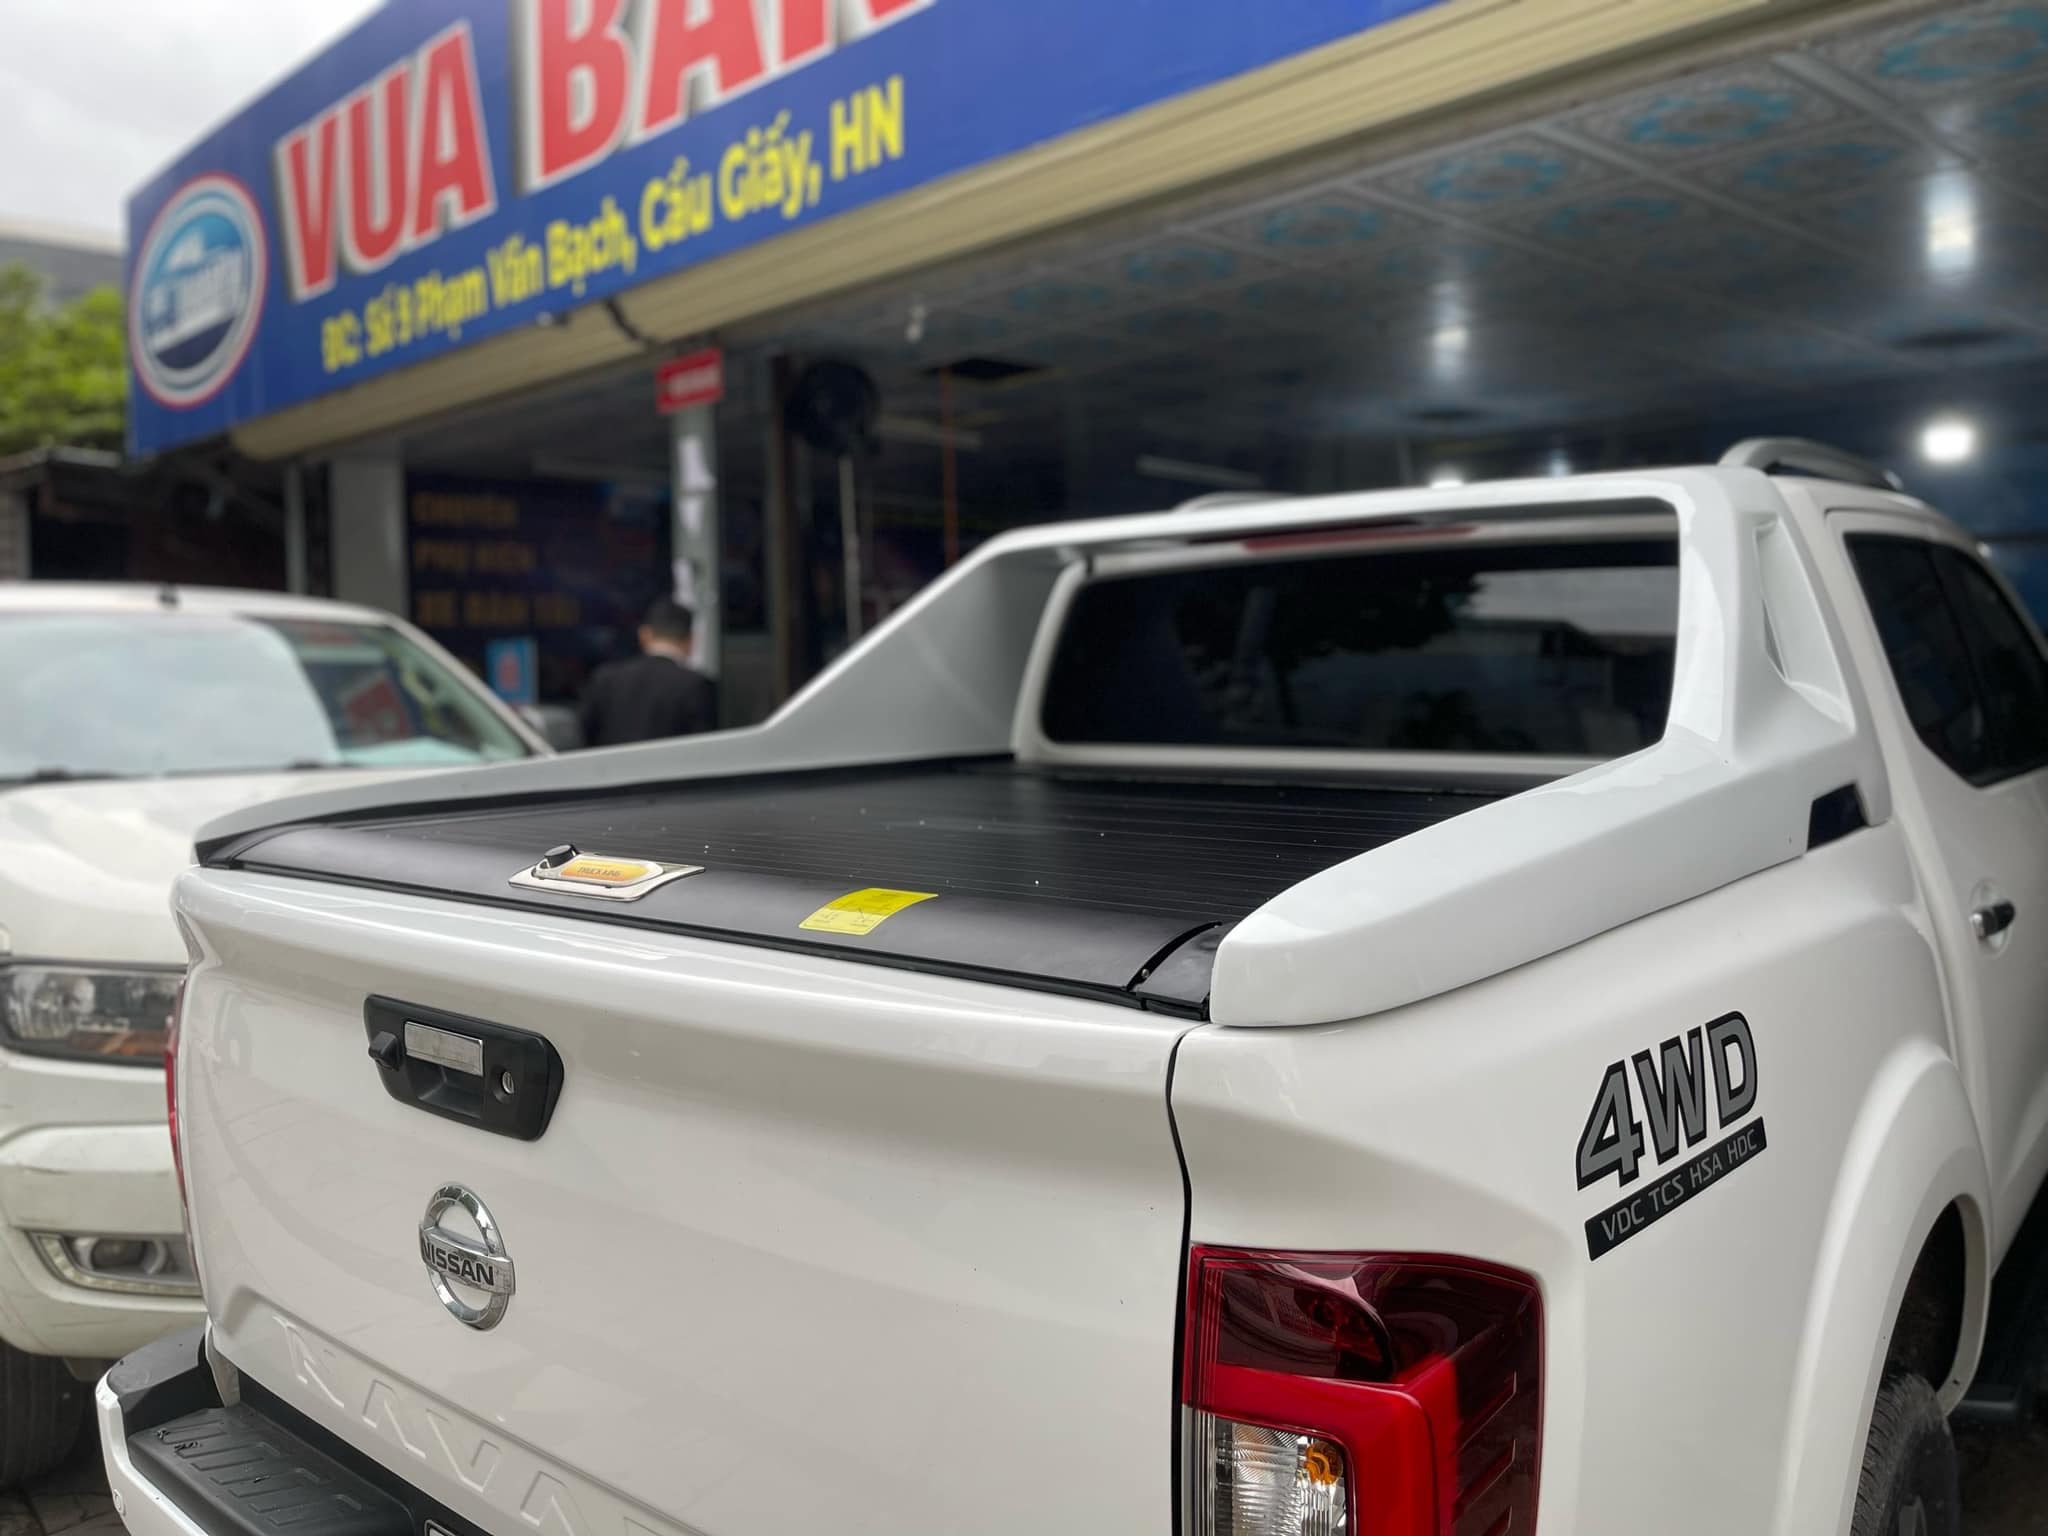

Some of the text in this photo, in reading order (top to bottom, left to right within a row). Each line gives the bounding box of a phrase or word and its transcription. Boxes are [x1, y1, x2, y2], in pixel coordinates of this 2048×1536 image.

[277, 22, 495, 297] VUA
[830, 75, 903, 182] HN
[1576, 1010, 1758, 1191] 4WD
[1601, 1128, 1757, 1241] VDC TCS HSA HDC
[422, 1240, 495, 1287] NISSAN
